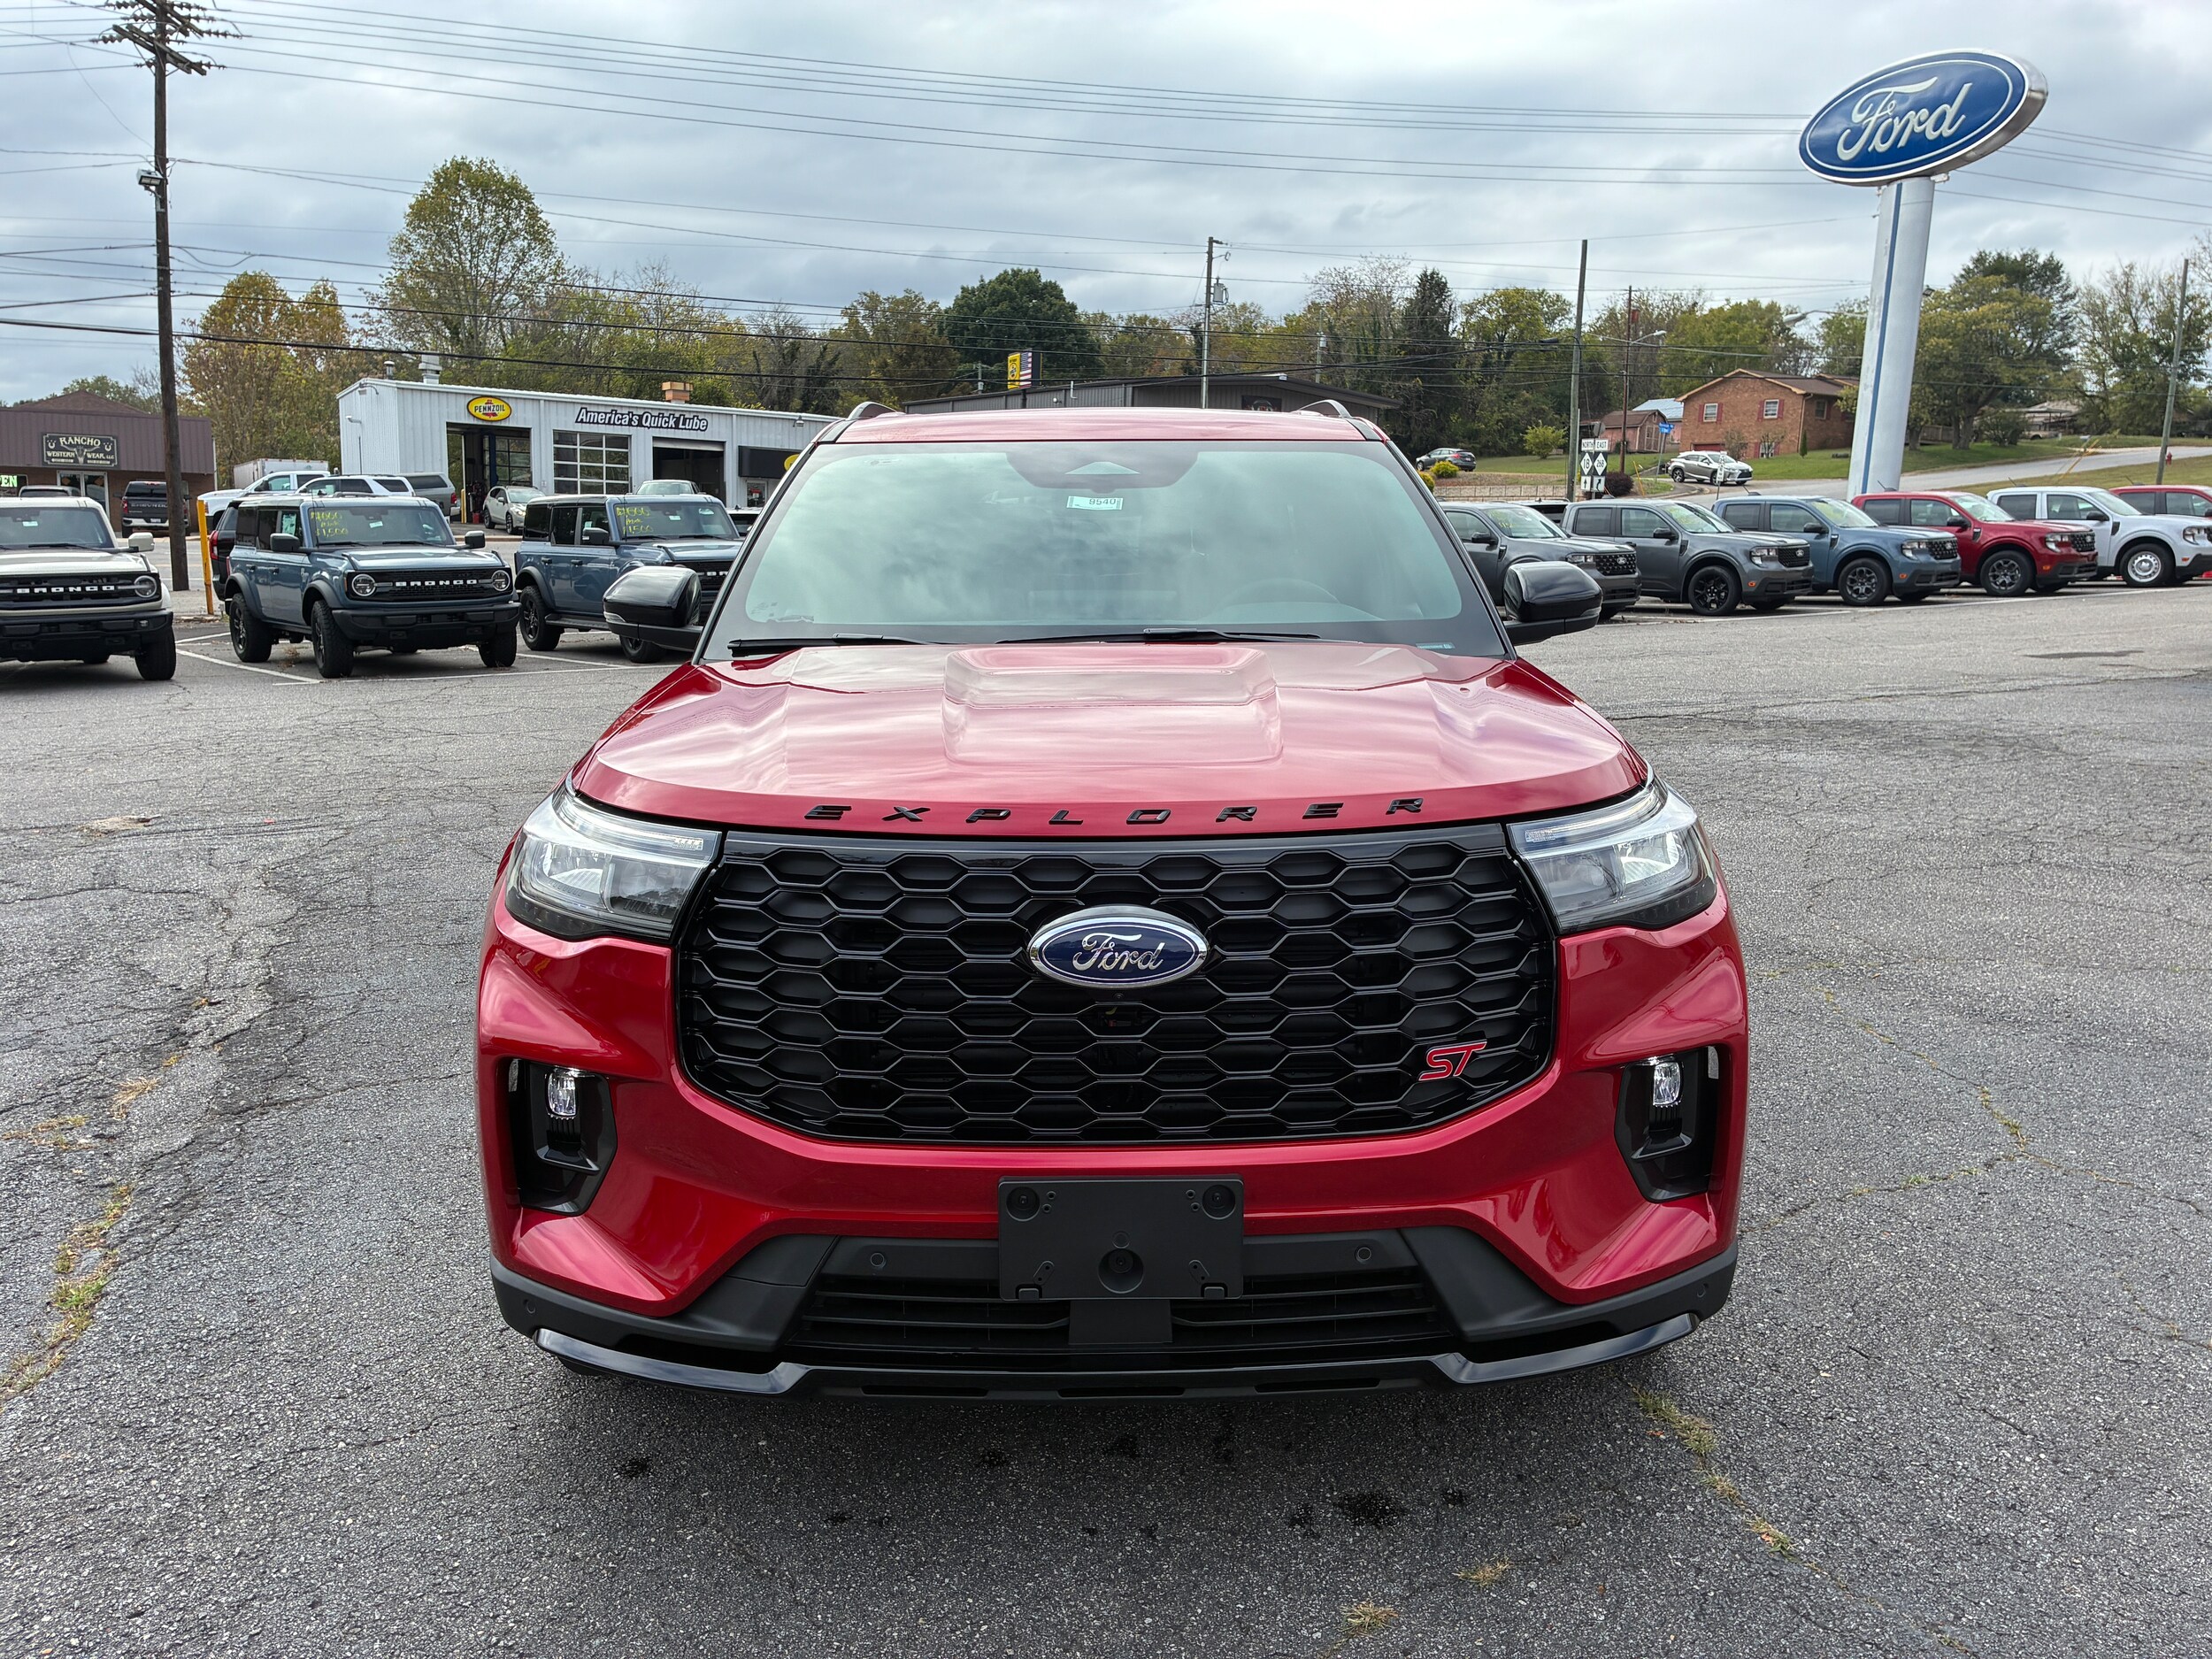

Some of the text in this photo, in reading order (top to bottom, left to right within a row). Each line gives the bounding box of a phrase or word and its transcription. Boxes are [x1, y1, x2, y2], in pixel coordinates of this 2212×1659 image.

[1836, 76, 1973, 161] Ford
[474, 403, 506, 413] PENNZOIL
[577, 408, 708, 431] America's Quick Lube
[59, 436, 101, 447] RANCHO
[1583, 458, 1590, 469] 18
[0, 474, 18, 488] EN
[16, 585, 115, 594] BRONCO
[803, 797, 1425, 826] EXPLORER
[1072, 932, 1166, 972] Ford
[1417, 1041, 1488, 1081] ST
